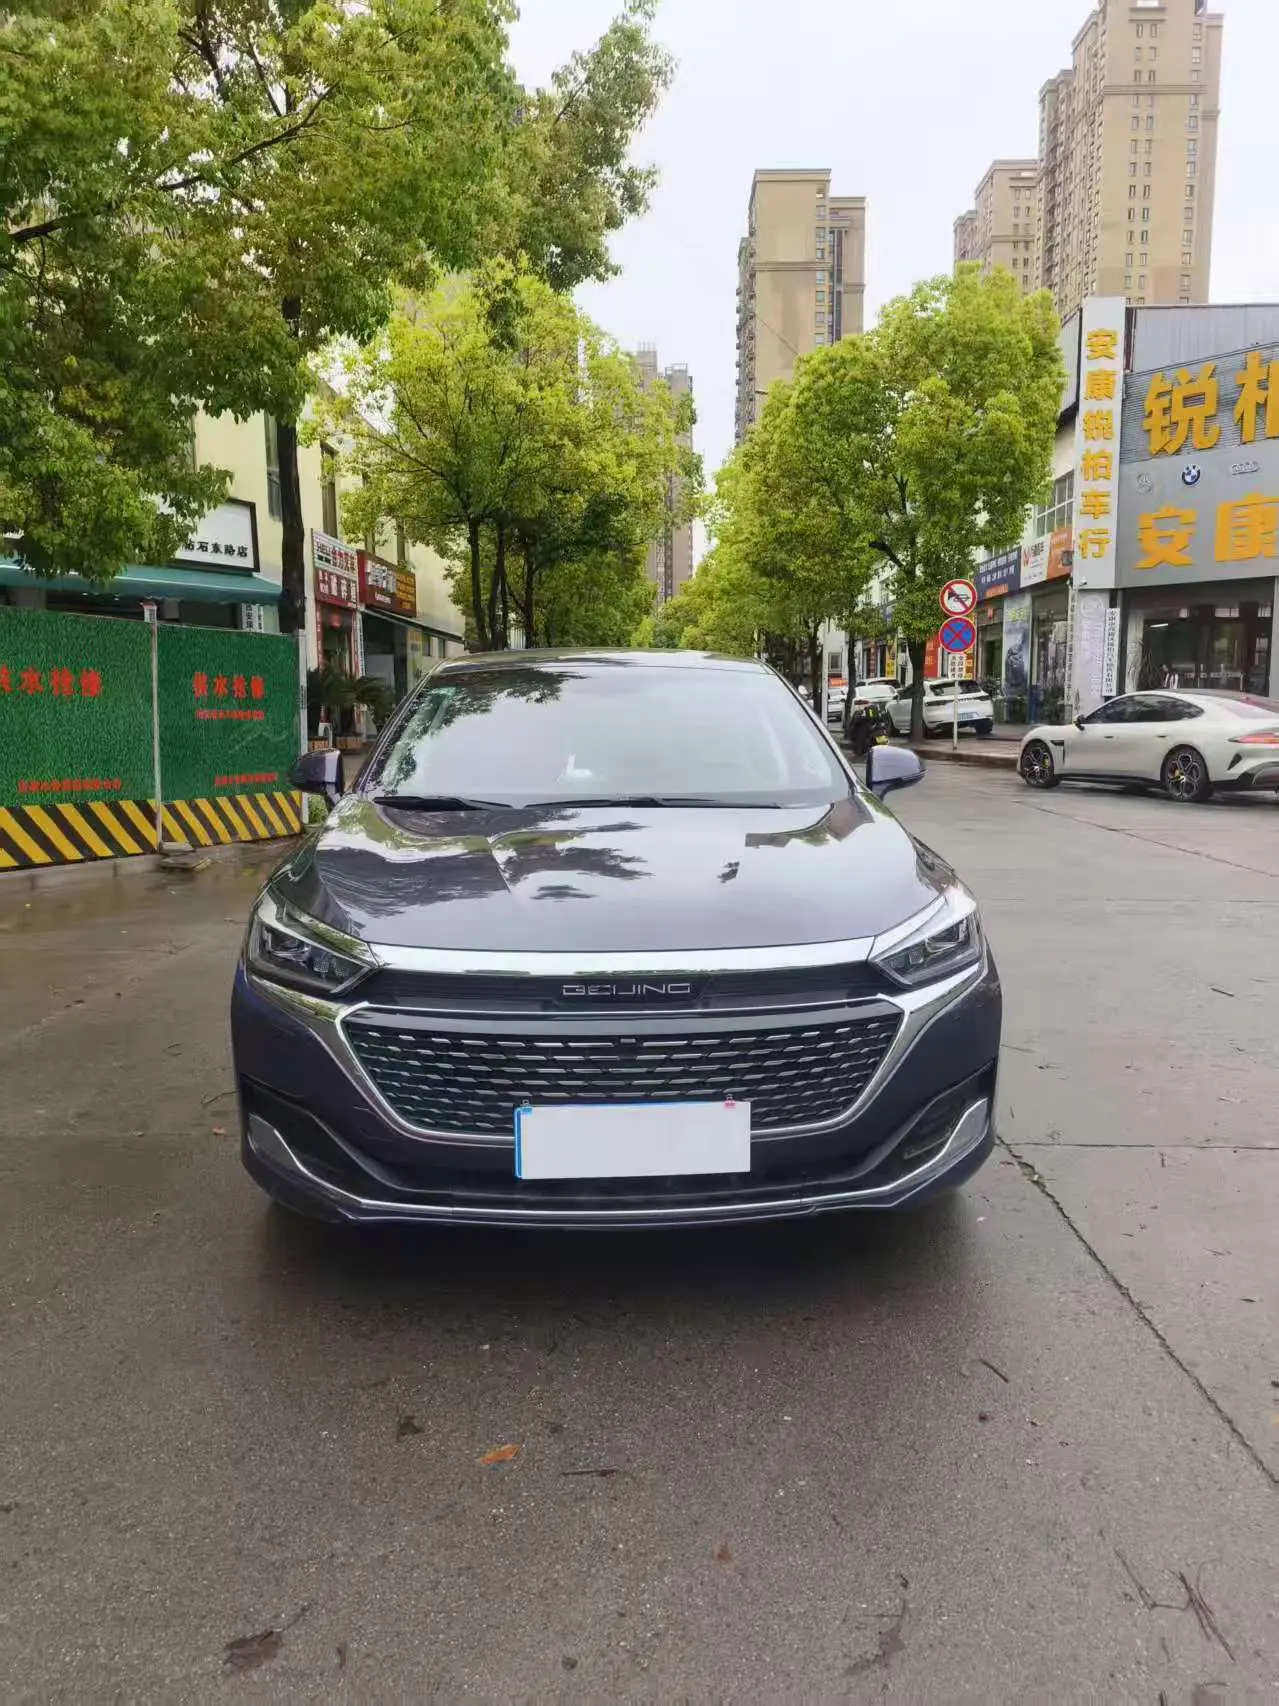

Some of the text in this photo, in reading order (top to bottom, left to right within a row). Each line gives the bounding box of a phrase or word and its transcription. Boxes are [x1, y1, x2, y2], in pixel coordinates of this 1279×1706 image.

[1078, 328, 1118, 560] 安康锐柏车行
[562, 983, 691, 996] BEIJING
